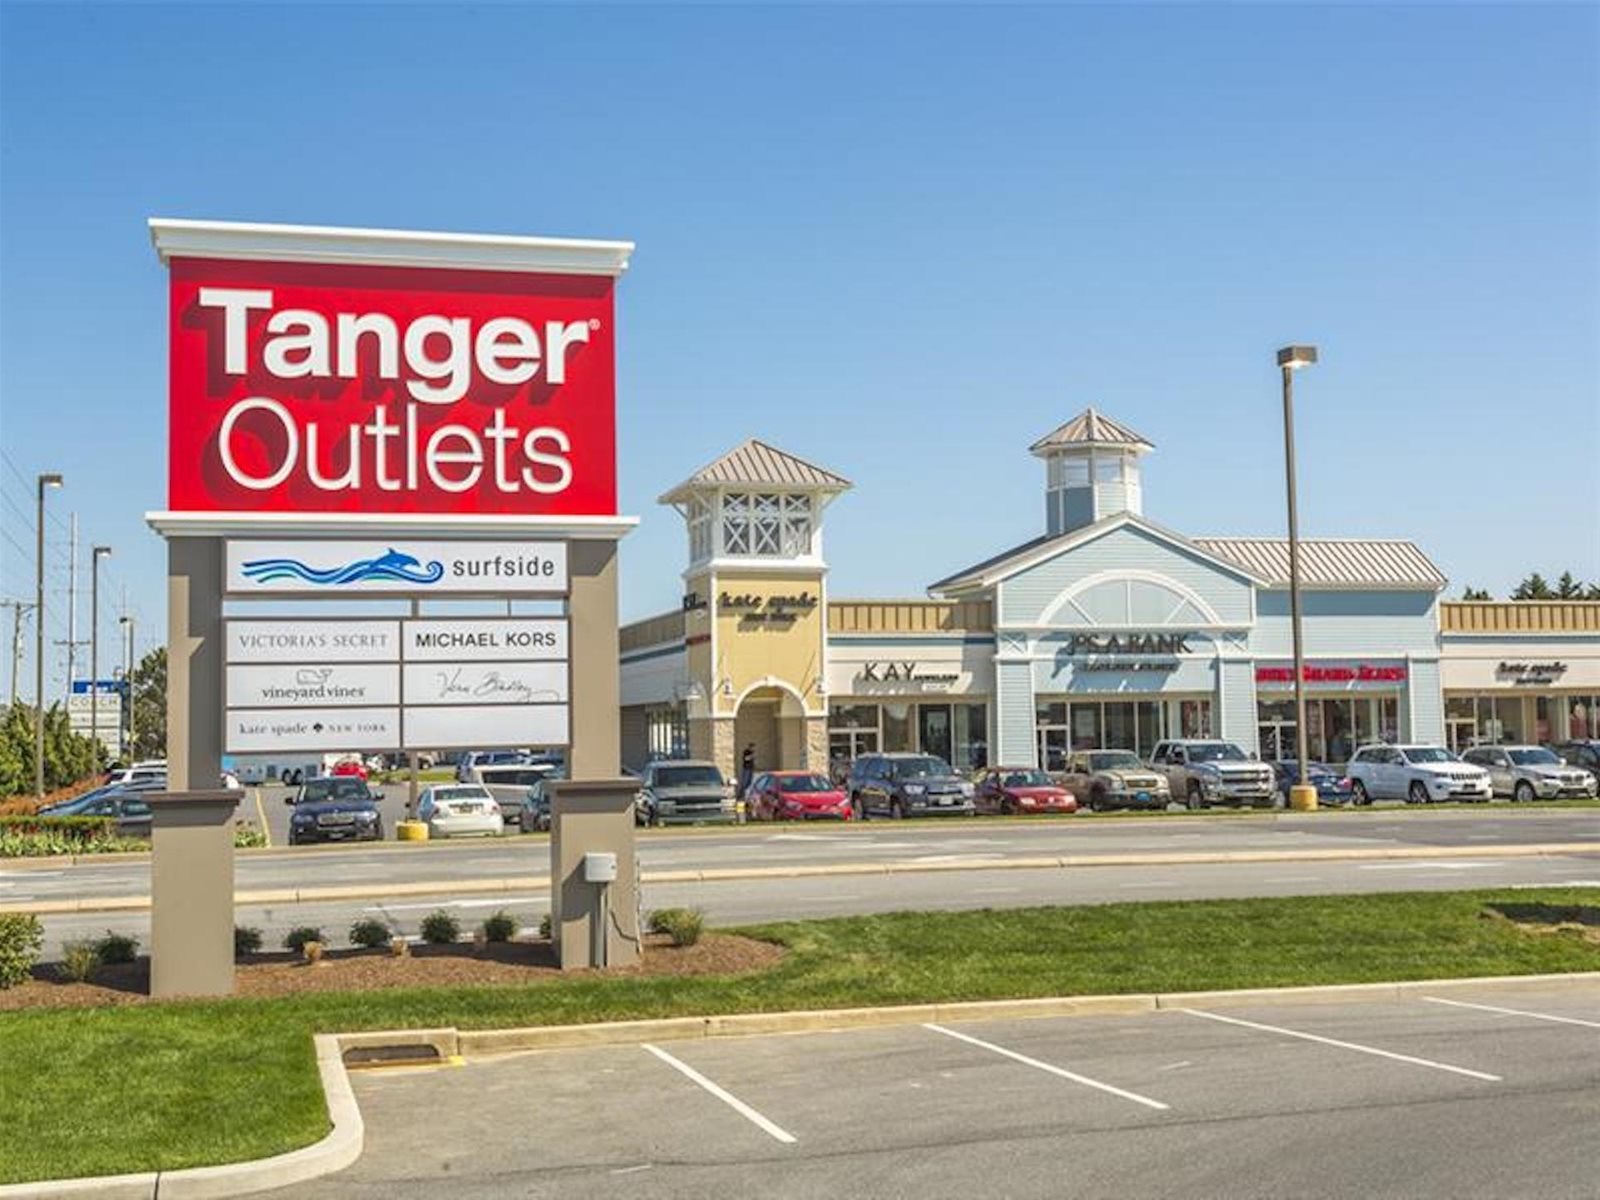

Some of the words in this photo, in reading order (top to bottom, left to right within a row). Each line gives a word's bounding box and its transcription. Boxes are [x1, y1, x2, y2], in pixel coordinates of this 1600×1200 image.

[199, 287, 589, 404] Tanger
[219, 397, 573, 493] Outlets
[453, 555, 554, 577] surfside
[239, 634, 326, 648] VICTORIA'S
[333, 634, 387, 648] SECRET
[415, 633, 499, 648] MICHAEL
[506, 631, 557, 647] KORS
[864, 661, 916, 682] KAY
[262, 684, 324, 701] vineyard
[326, 685, 365, 698] vines
[239, 723, 266, 735] kate
[271, 722, 308, 736] spade
